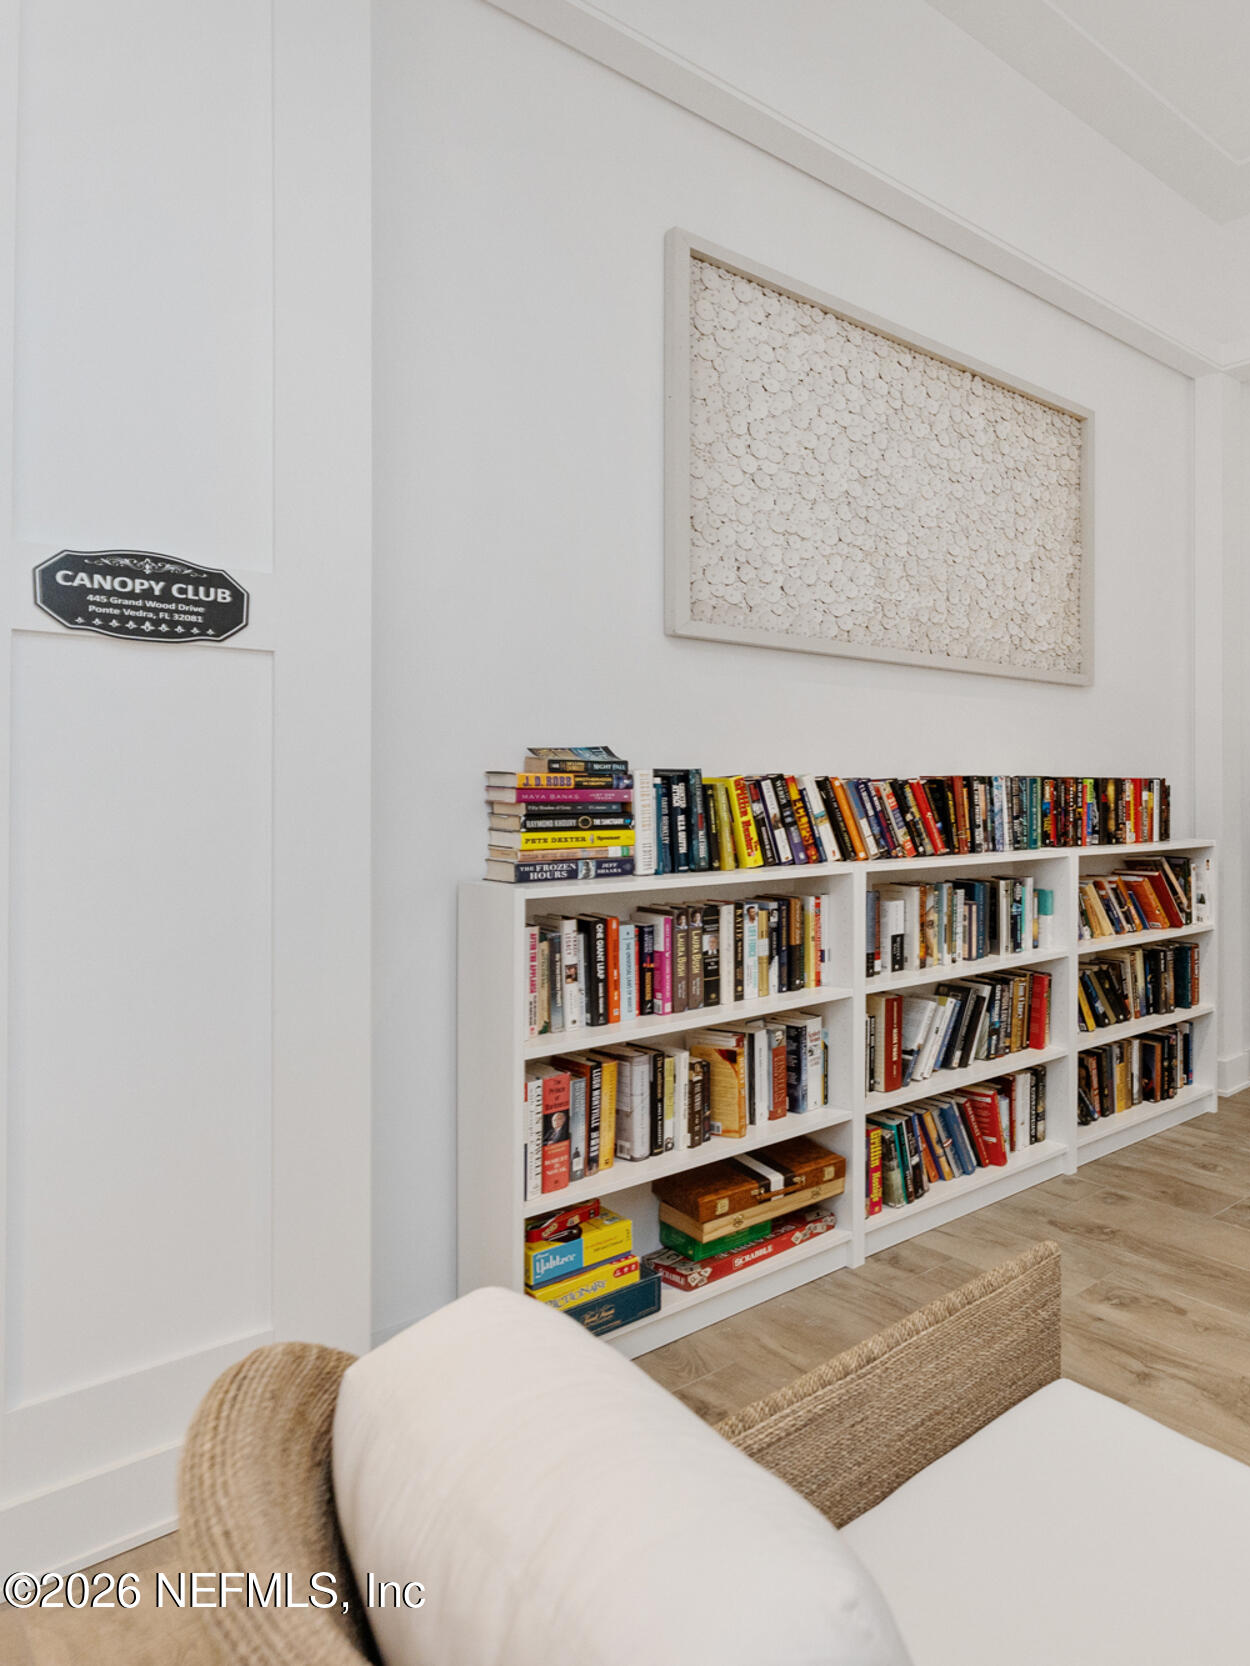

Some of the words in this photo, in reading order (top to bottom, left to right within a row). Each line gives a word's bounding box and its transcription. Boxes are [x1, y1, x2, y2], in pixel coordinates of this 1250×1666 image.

[55, 570, 166, 596] CANOPY
[171, 583, 233, 604] CLUB
[86, 594, 108, 603] 445
[109, 597, 143, 606] Grand
[145, 600, 176, 609] Wood
[178, 604, 206, 613] Drive
[88, 605, 121, 615] Ponte
[122, 608, 157, 619] Vedra,
[159, 612, 170, 620] FL
[172, 613, 204, 623] 32081
[522, 776, 532, 787] J.
[546, 776, 573, 787] ROBB
[672, 784, 680, 808] ATTACK
[524, 837, 549, 845] PETE
[551, 836, 588, 844] DEXTER
[529, 870, 569, 880] HOURS
[535, 862, 577, 872] FROZEN
[596, 923, 604, 939] ONE
[735, 909, 744, 940] KATIE
[595, 939, 604, 962] GIANT
[676, 932, 687, 956] LAURA
[691, 930, 703, 954] LAURA
[595, 962, 604, 980] LEAP
[677, 956, 688, 977] BUSH
[691, 954, 703, 974] BUSH
[592, 1068, 601, 1090] LEIGH
[776, 1054, 785, 1102] EINSTEIN
[591, 1090, 601, 1129] MONTVILLE
[869, 1130, 882, 1169] Griffin
[733, 1244, 774, 1268] SCRABBLE
